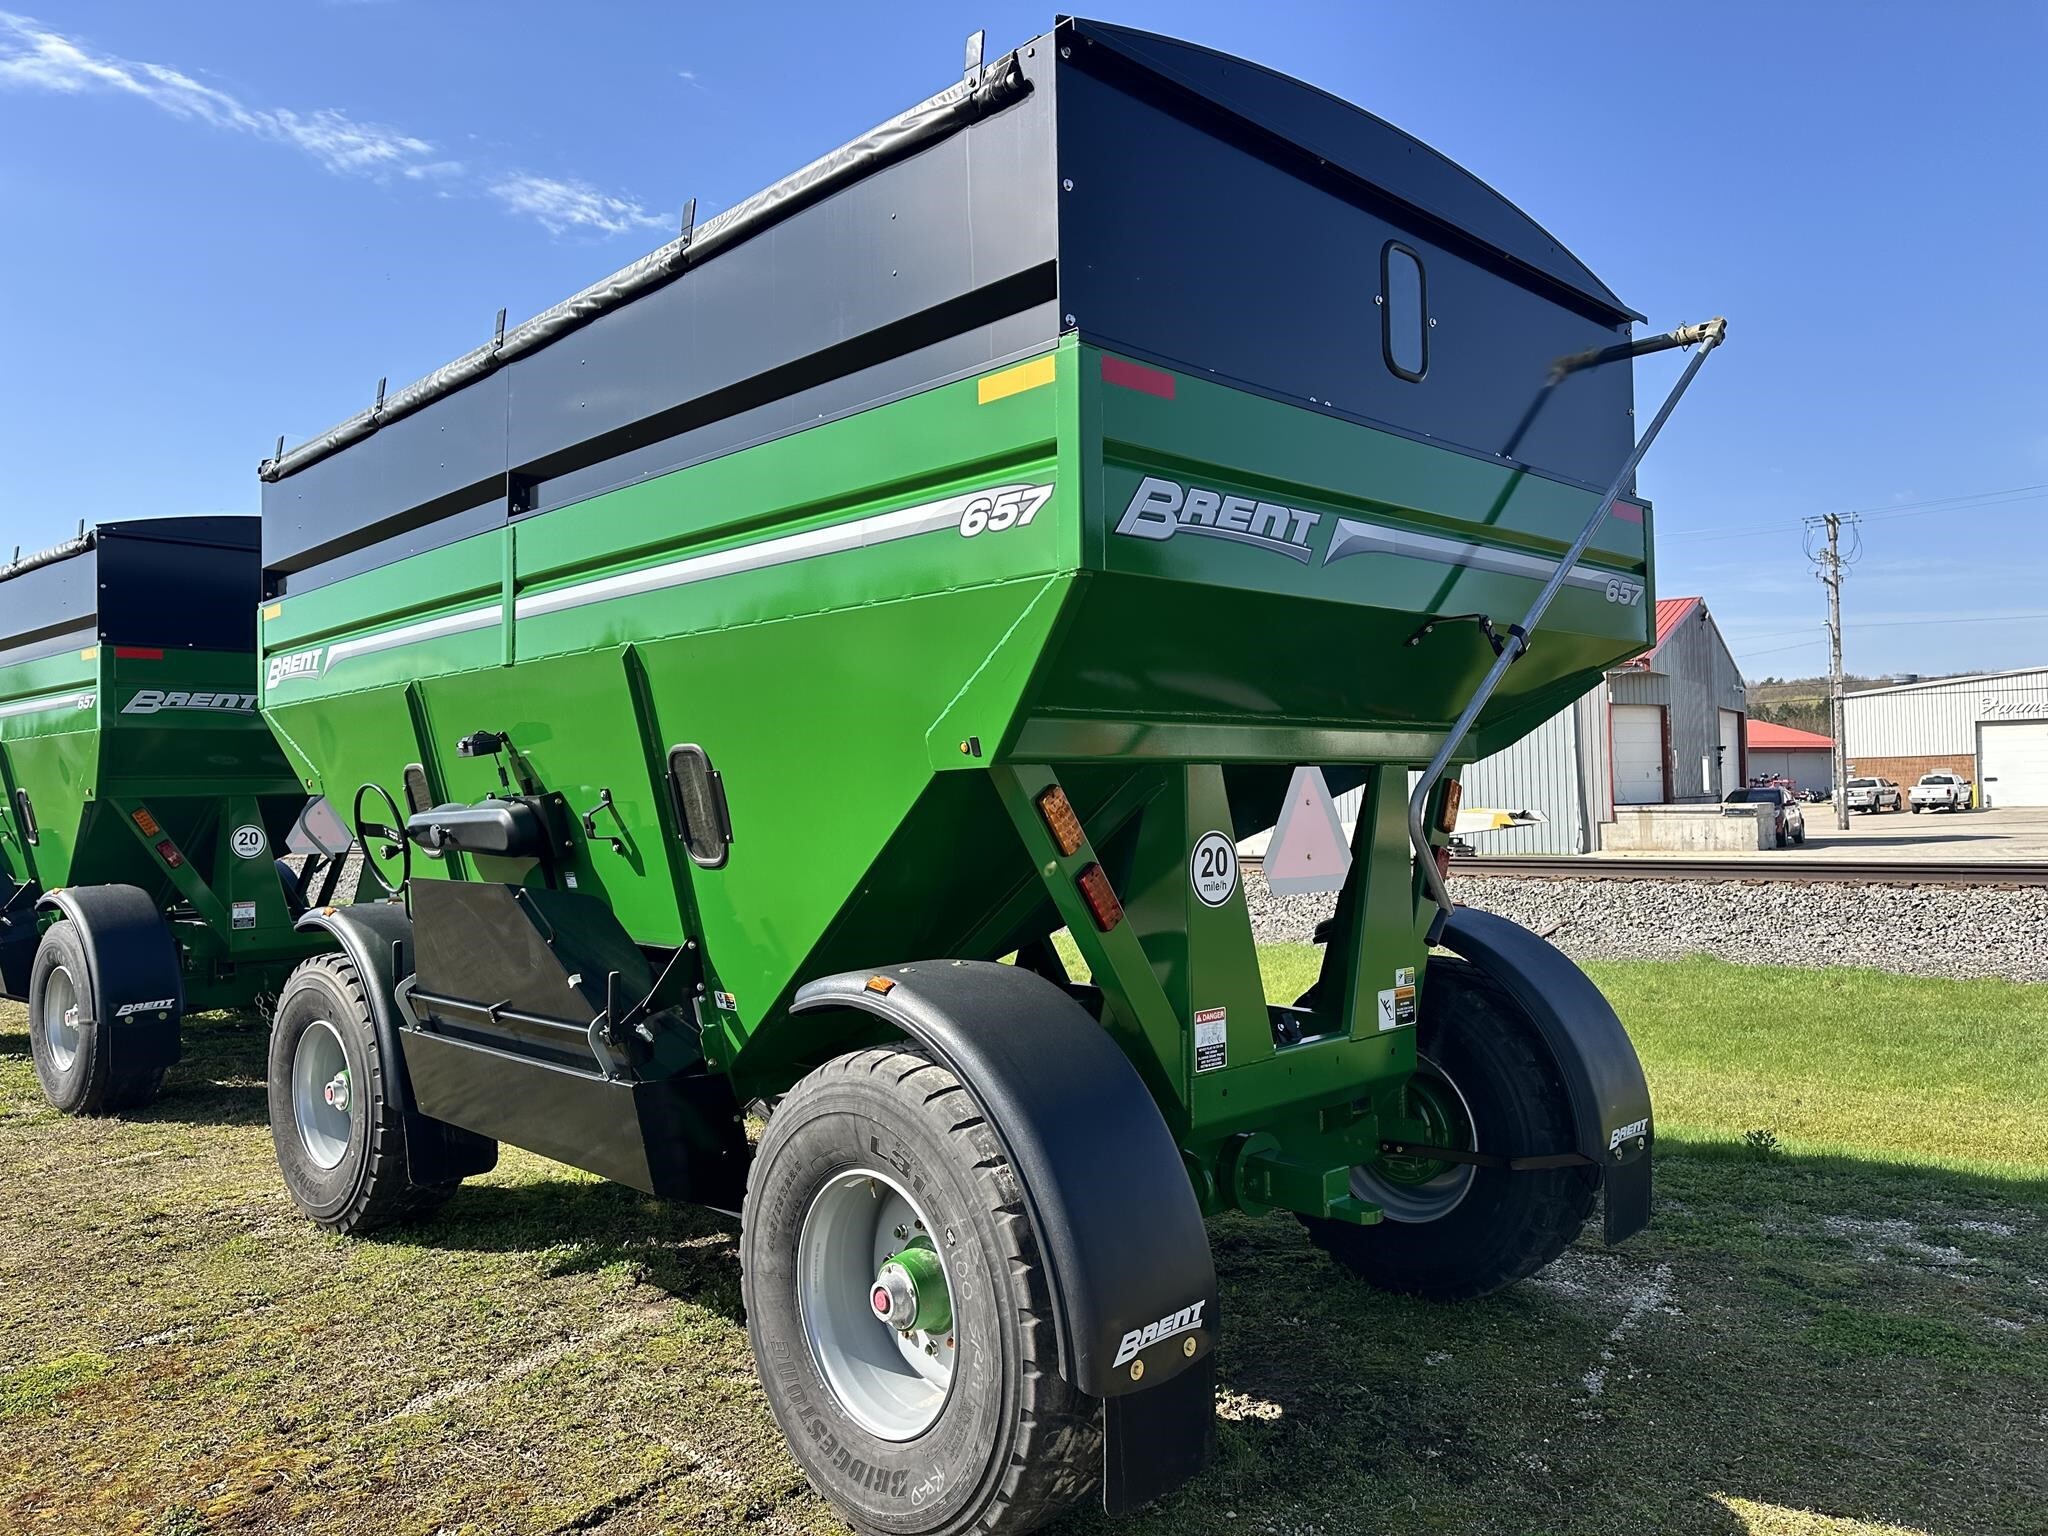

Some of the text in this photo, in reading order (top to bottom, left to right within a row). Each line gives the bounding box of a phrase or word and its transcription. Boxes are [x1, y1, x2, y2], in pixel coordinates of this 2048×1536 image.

[958, 482, 1056, 538] 657
[1114, 474, 1321, 554] BRENT
[1605, 578, 1645, 607] 657
[265, 648, 323, 690] BRENT
[77, 694, 96, 711] 657
[120, 689, 258, 715] BRENT
[238, 831, 259, 846] 20
[1200, 846, 1228, 878] 20
[1203, 880, 1227, 892] mile/h
[115, 998, 176, 1017] BRENT
[1202, 1010, 1225, 1022] DANGER
[1608, 1117, 1649, 1151] BRENT
[1112, 1299, 1206, 1369] BRENT
[771, 1341, 912, 1500] BRIDGESTONE
